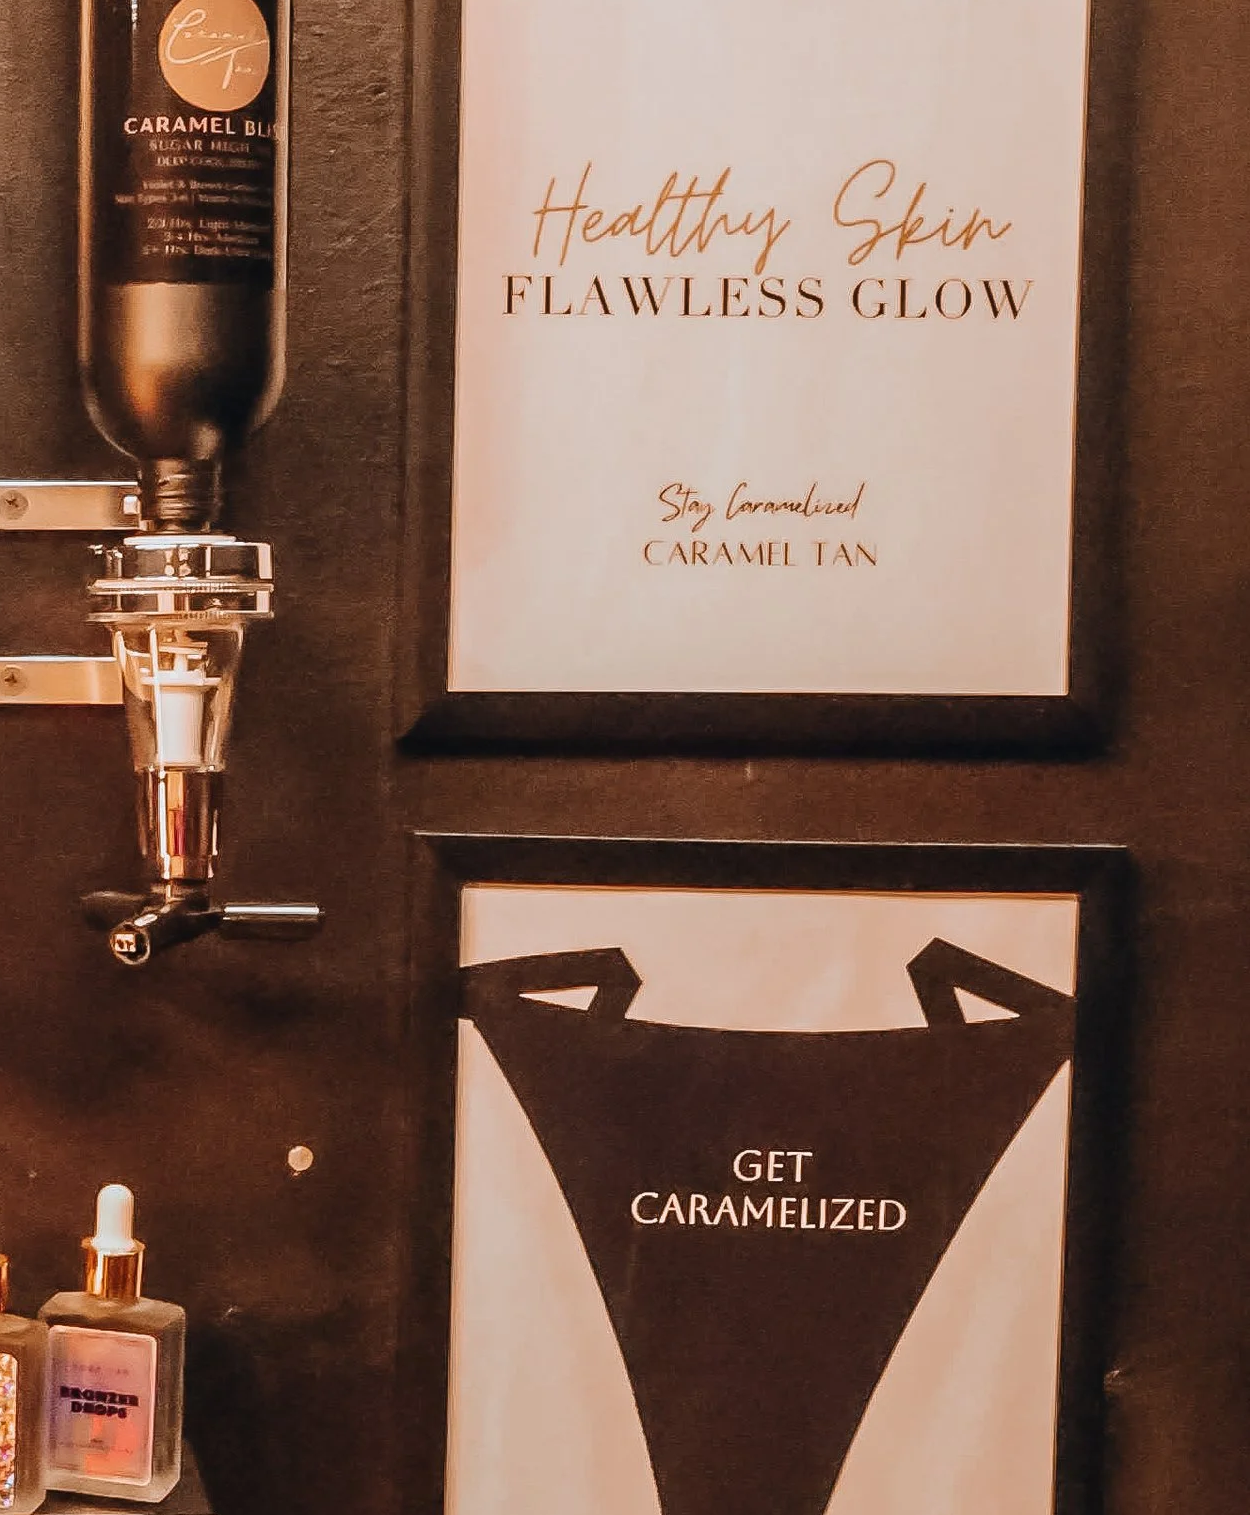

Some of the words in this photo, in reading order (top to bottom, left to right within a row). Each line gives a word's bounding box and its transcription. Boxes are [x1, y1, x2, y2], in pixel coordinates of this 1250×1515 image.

[124, 116, 236, 135] CARAMEL
[149, 139, 203, 152] SUGAR
[533, 161, 790, 274] Healthy
[834, 160, 1012, 265] Skin
[502, 275, 825, 319] FLAWLESS
[851, 278, 1034, 321] GLOW
[659, 482, 714, 533] Stay
[726, 482, 866, 519] Caramelized
[644, 540, 797, 566] CARAMEL
[811, 540, 877, 567] TAN
[732, 1150, 813, 1182] GET
[631, 1192, 907, 1231] CARAMELIZED
